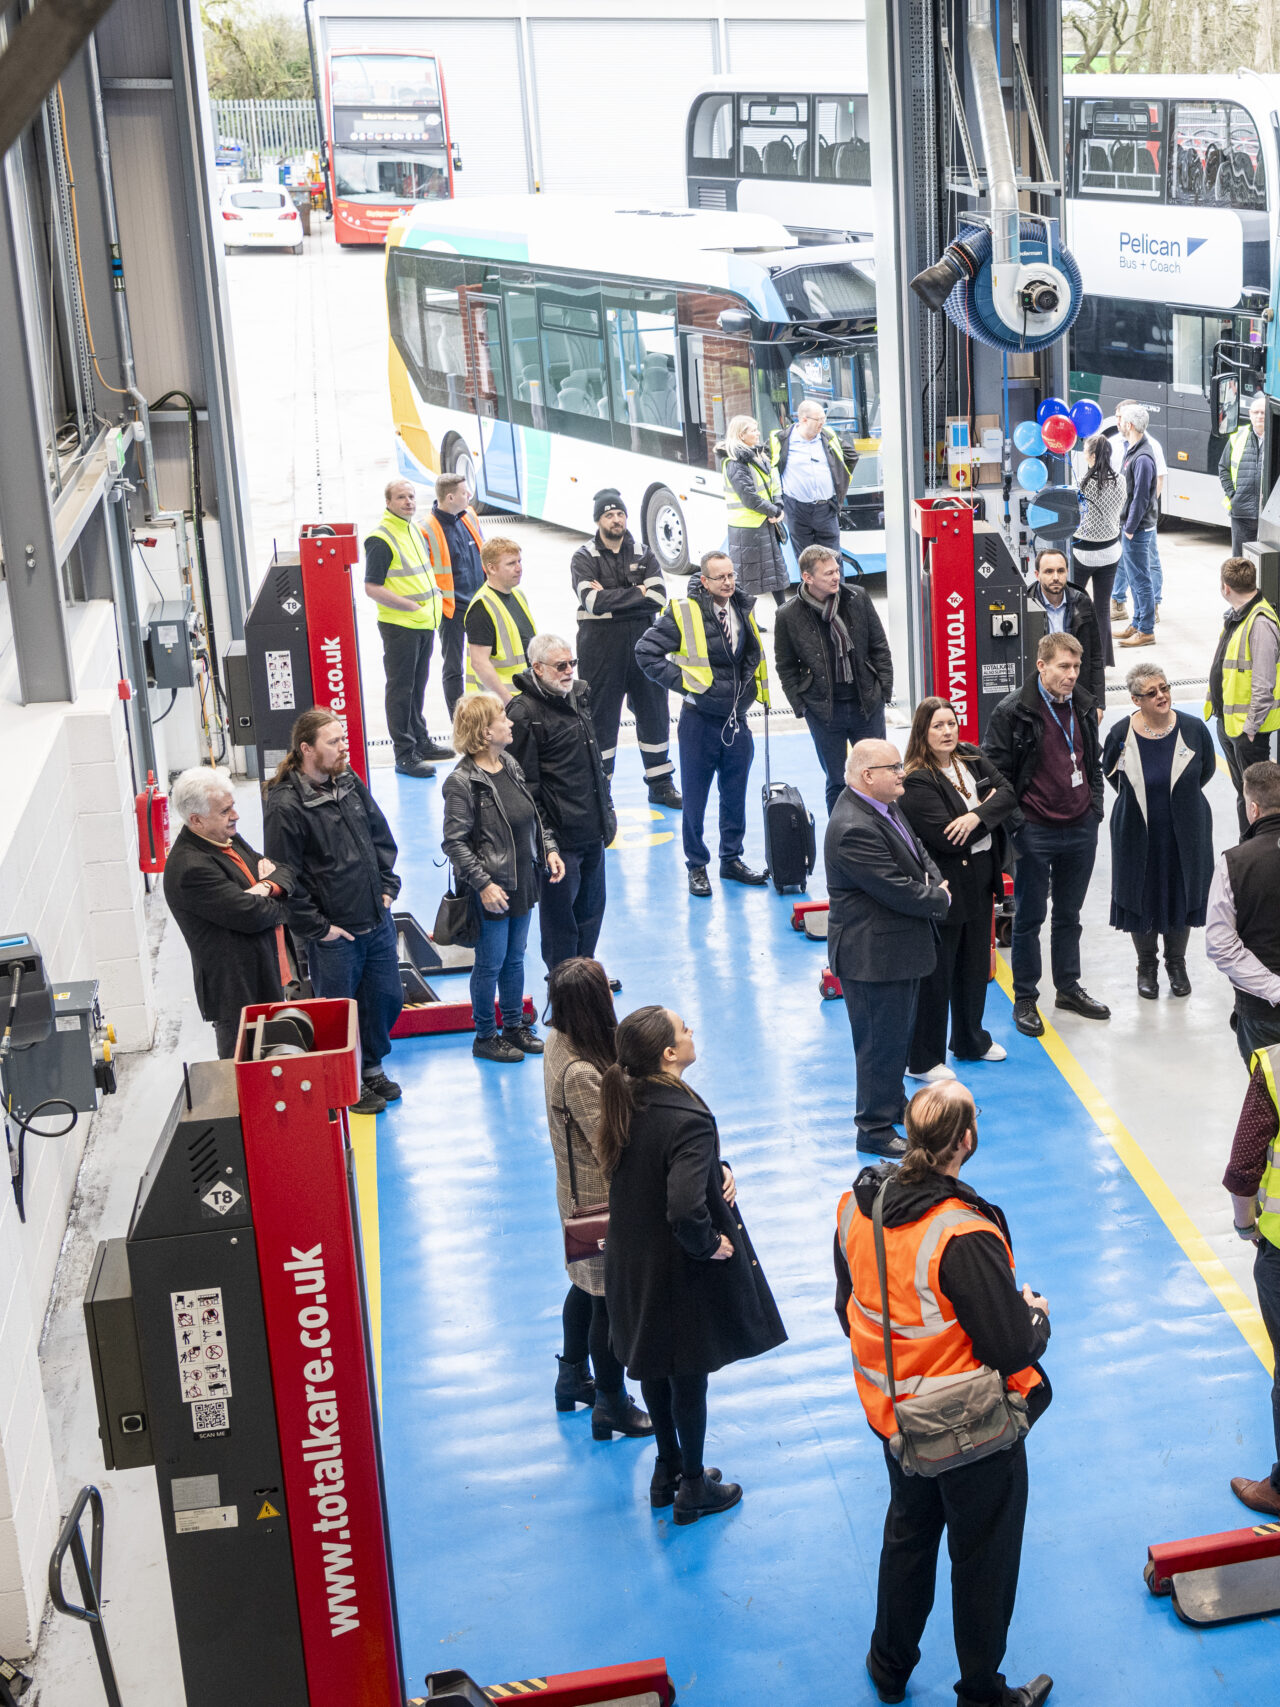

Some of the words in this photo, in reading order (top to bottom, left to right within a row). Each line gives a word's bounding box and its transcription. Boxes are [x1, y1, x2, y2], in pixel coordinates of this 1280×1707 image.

[1119, 232, 1181, 257] Pelican
[1119, 256, 1137, 270] Bus
[1150, 259, 1181, 273] Coach
[981, 566, 991, 574] T8
[286, 602, 298, 610] T8
[946, 610, 968, 727] TOTALKARE
[210, 1190, 233, 1205] T8
[283, 1242, 361, 1638] www.totalkare.co.uk
